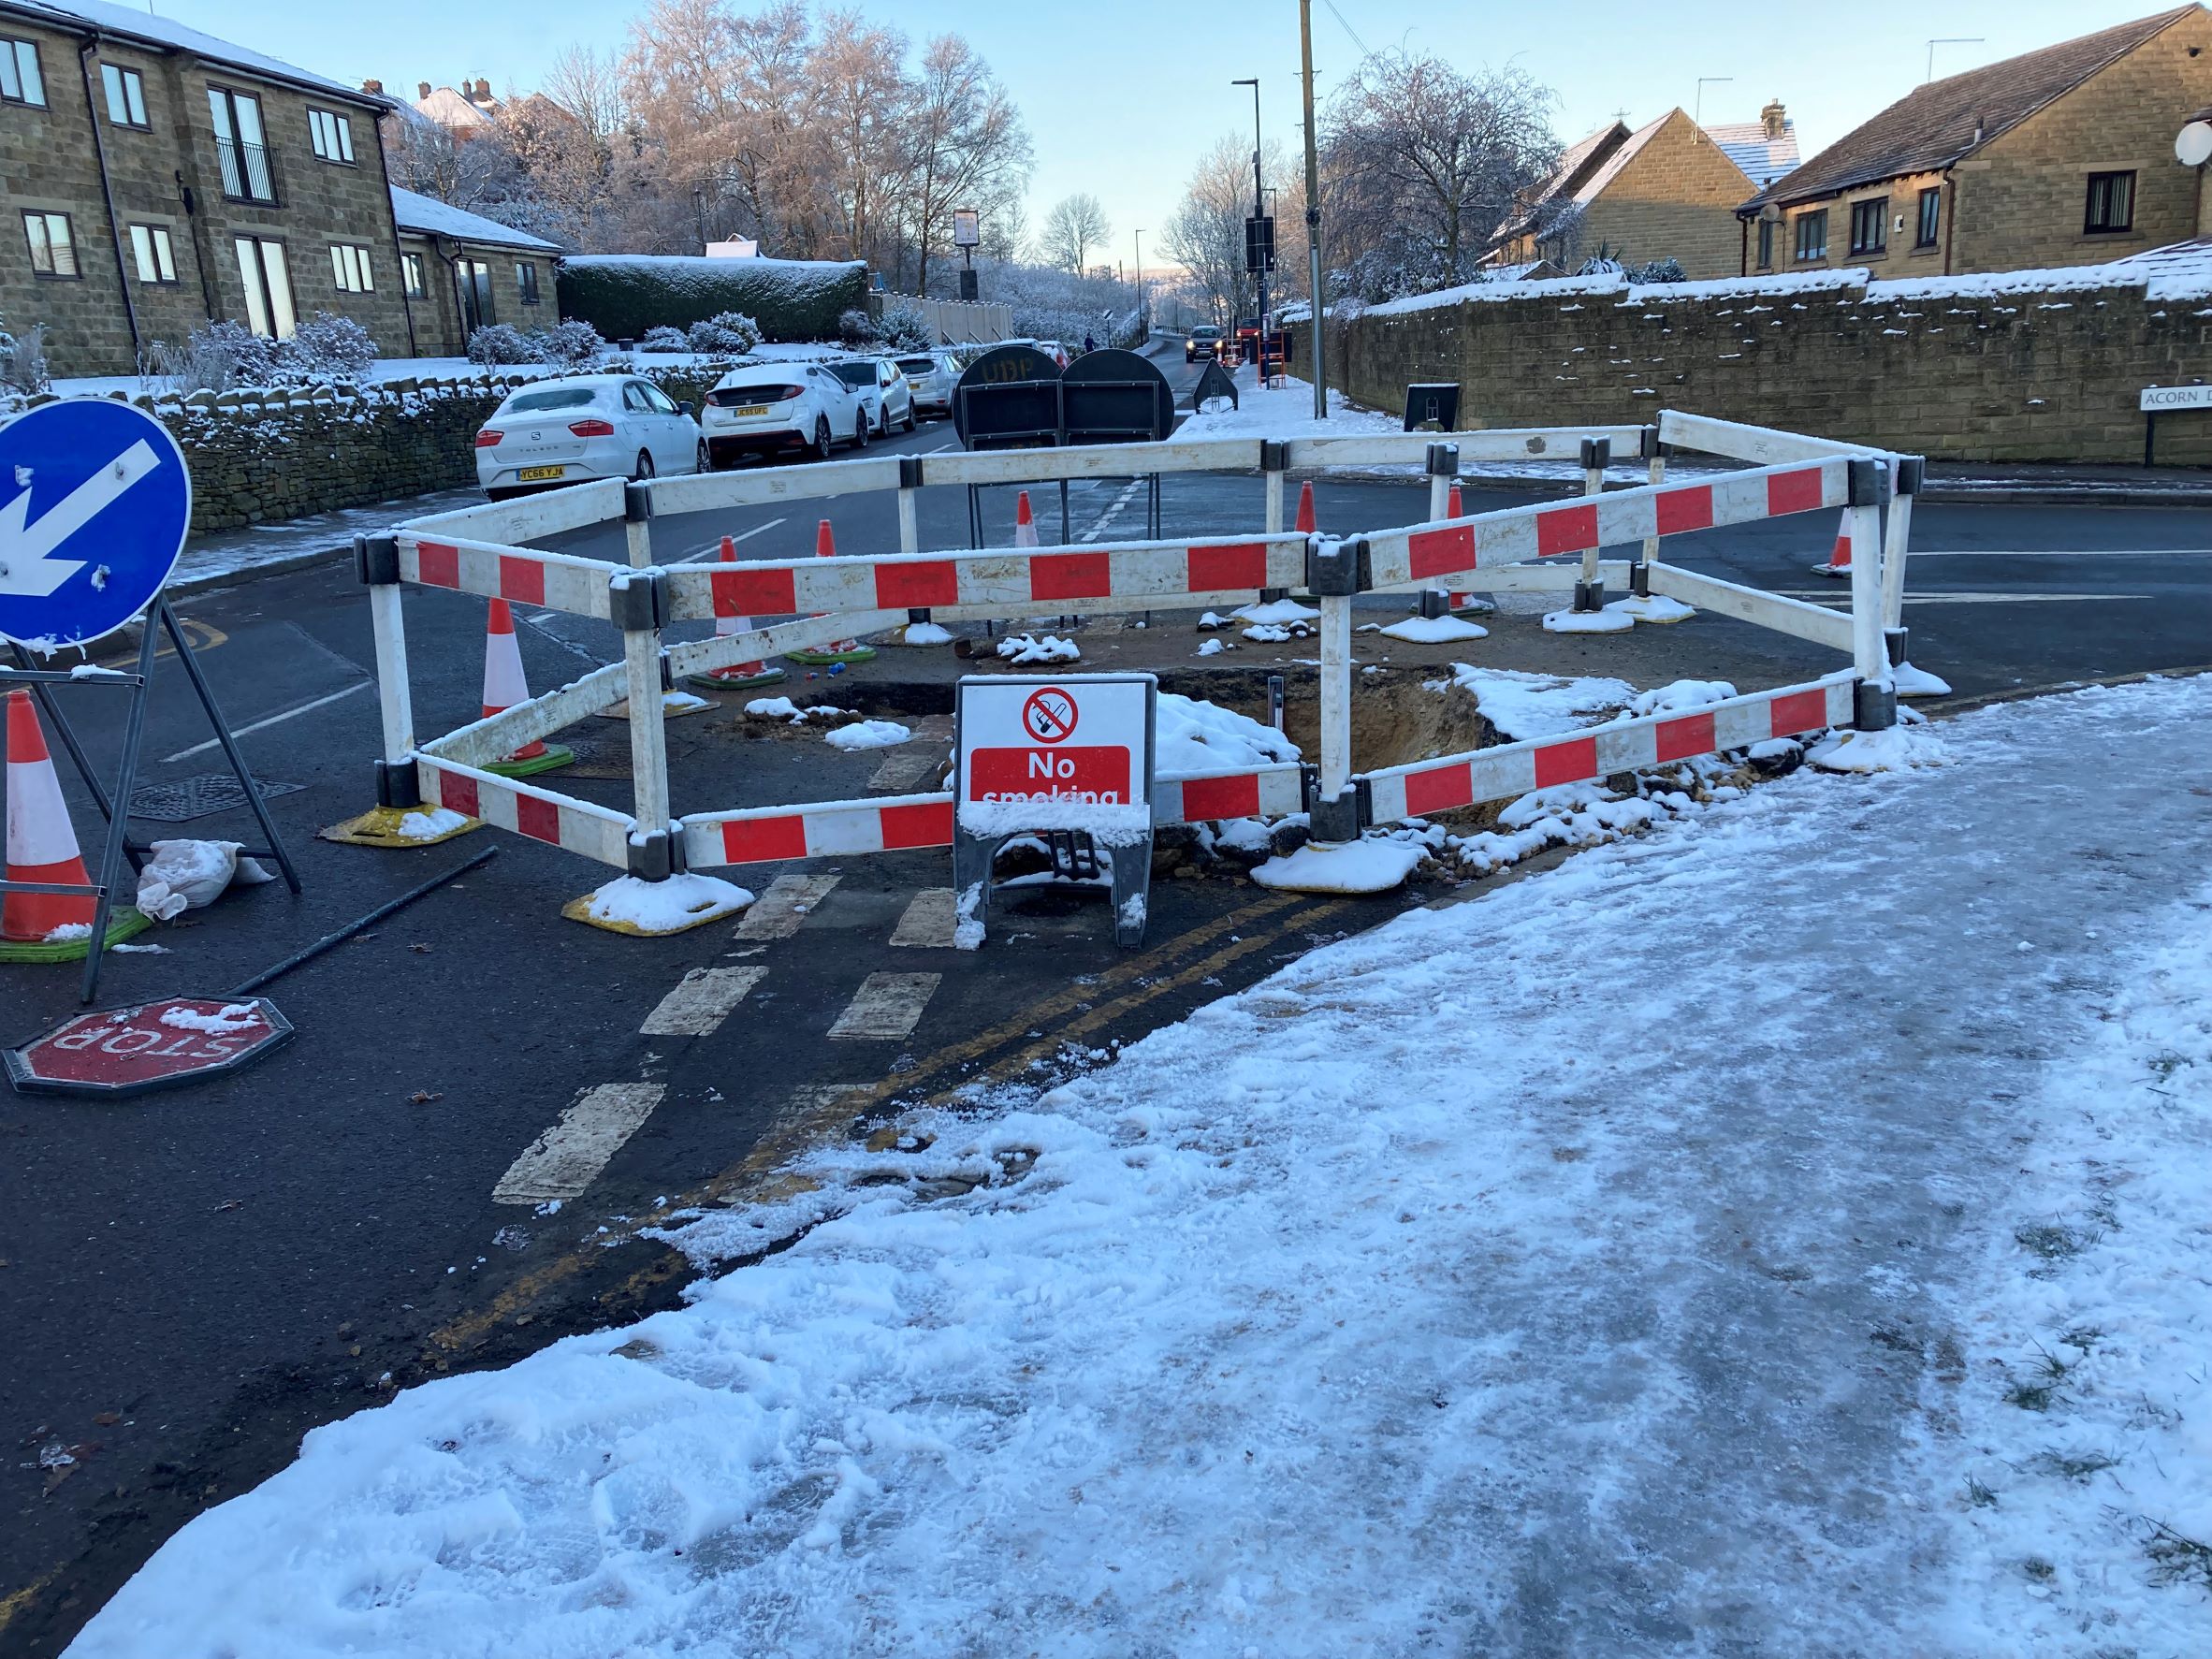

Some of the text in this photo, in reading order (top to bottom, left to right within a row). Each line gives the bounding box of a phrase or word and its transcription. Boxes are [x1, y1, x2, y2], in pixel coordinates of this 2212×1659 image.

[2145, 391, 2198, 405] ACORN
[521, 467, 563, 479] YC66 YJA
[1027, 751, 1076, 779] No
[52, 1027, 247, 1058] STOP
